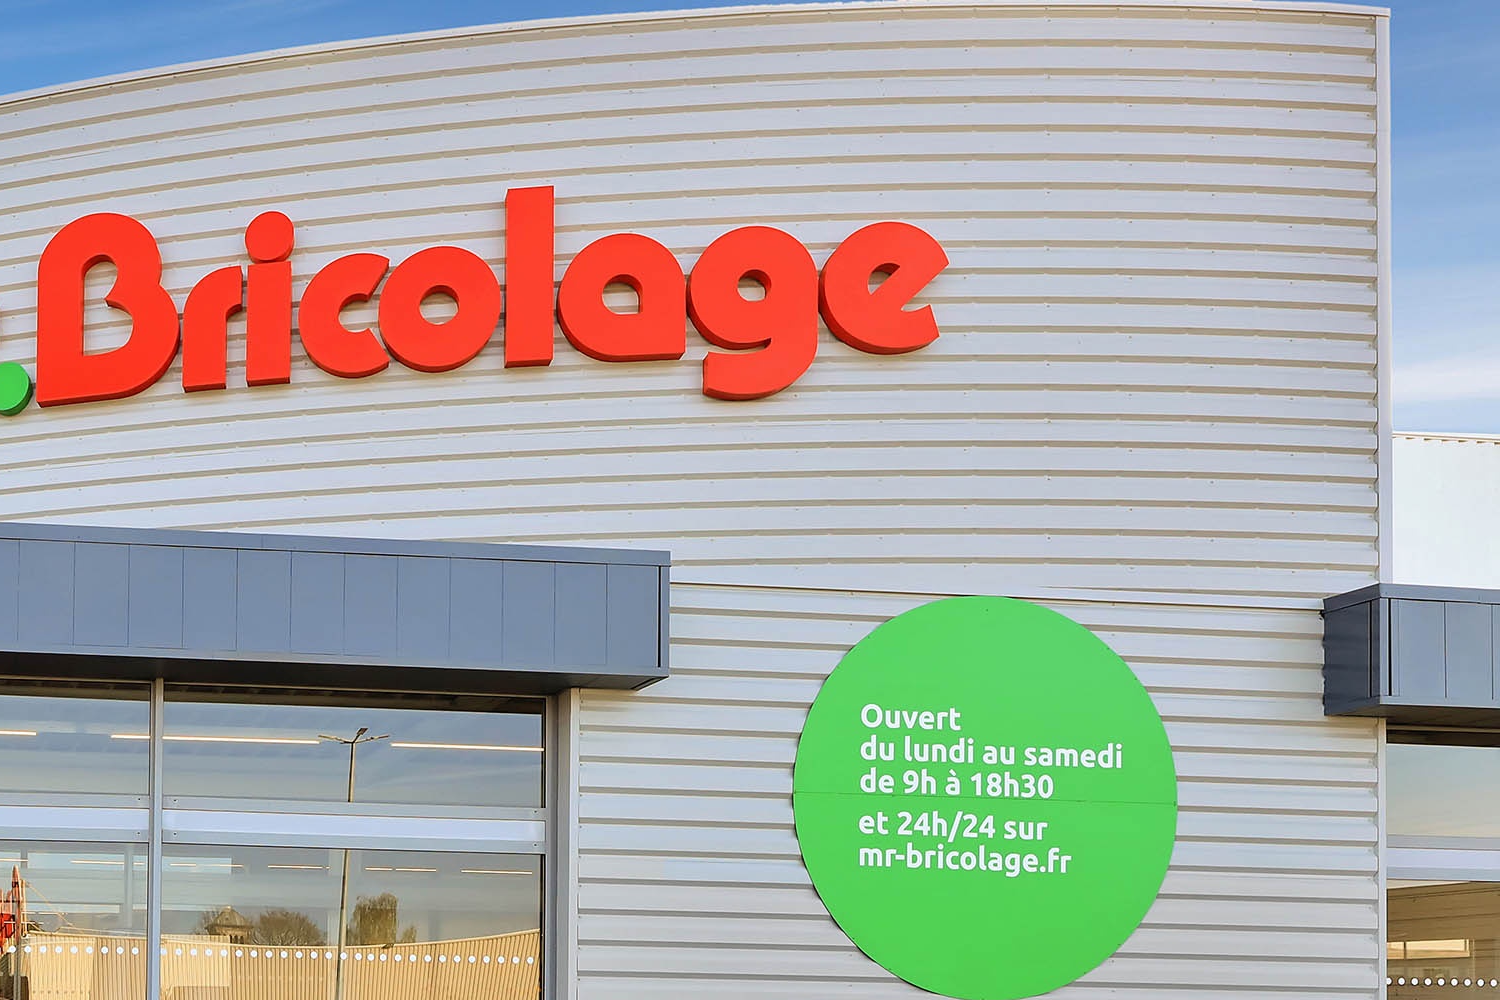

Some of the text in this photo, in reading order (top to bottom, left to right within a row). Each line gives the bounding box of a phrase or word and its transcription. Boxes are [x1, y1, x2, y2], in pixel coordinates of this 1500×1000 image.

[860, 703, 962, 731] Ouvert
[860, 734, 1123, 769] du lundi au samedi
[860, 766, 1054, 799] de 9h à 18h30
[858, 810, 1048, 843] et 24h/24 sur
[859, 842, 1072, 878] mr-bricolage.fr
